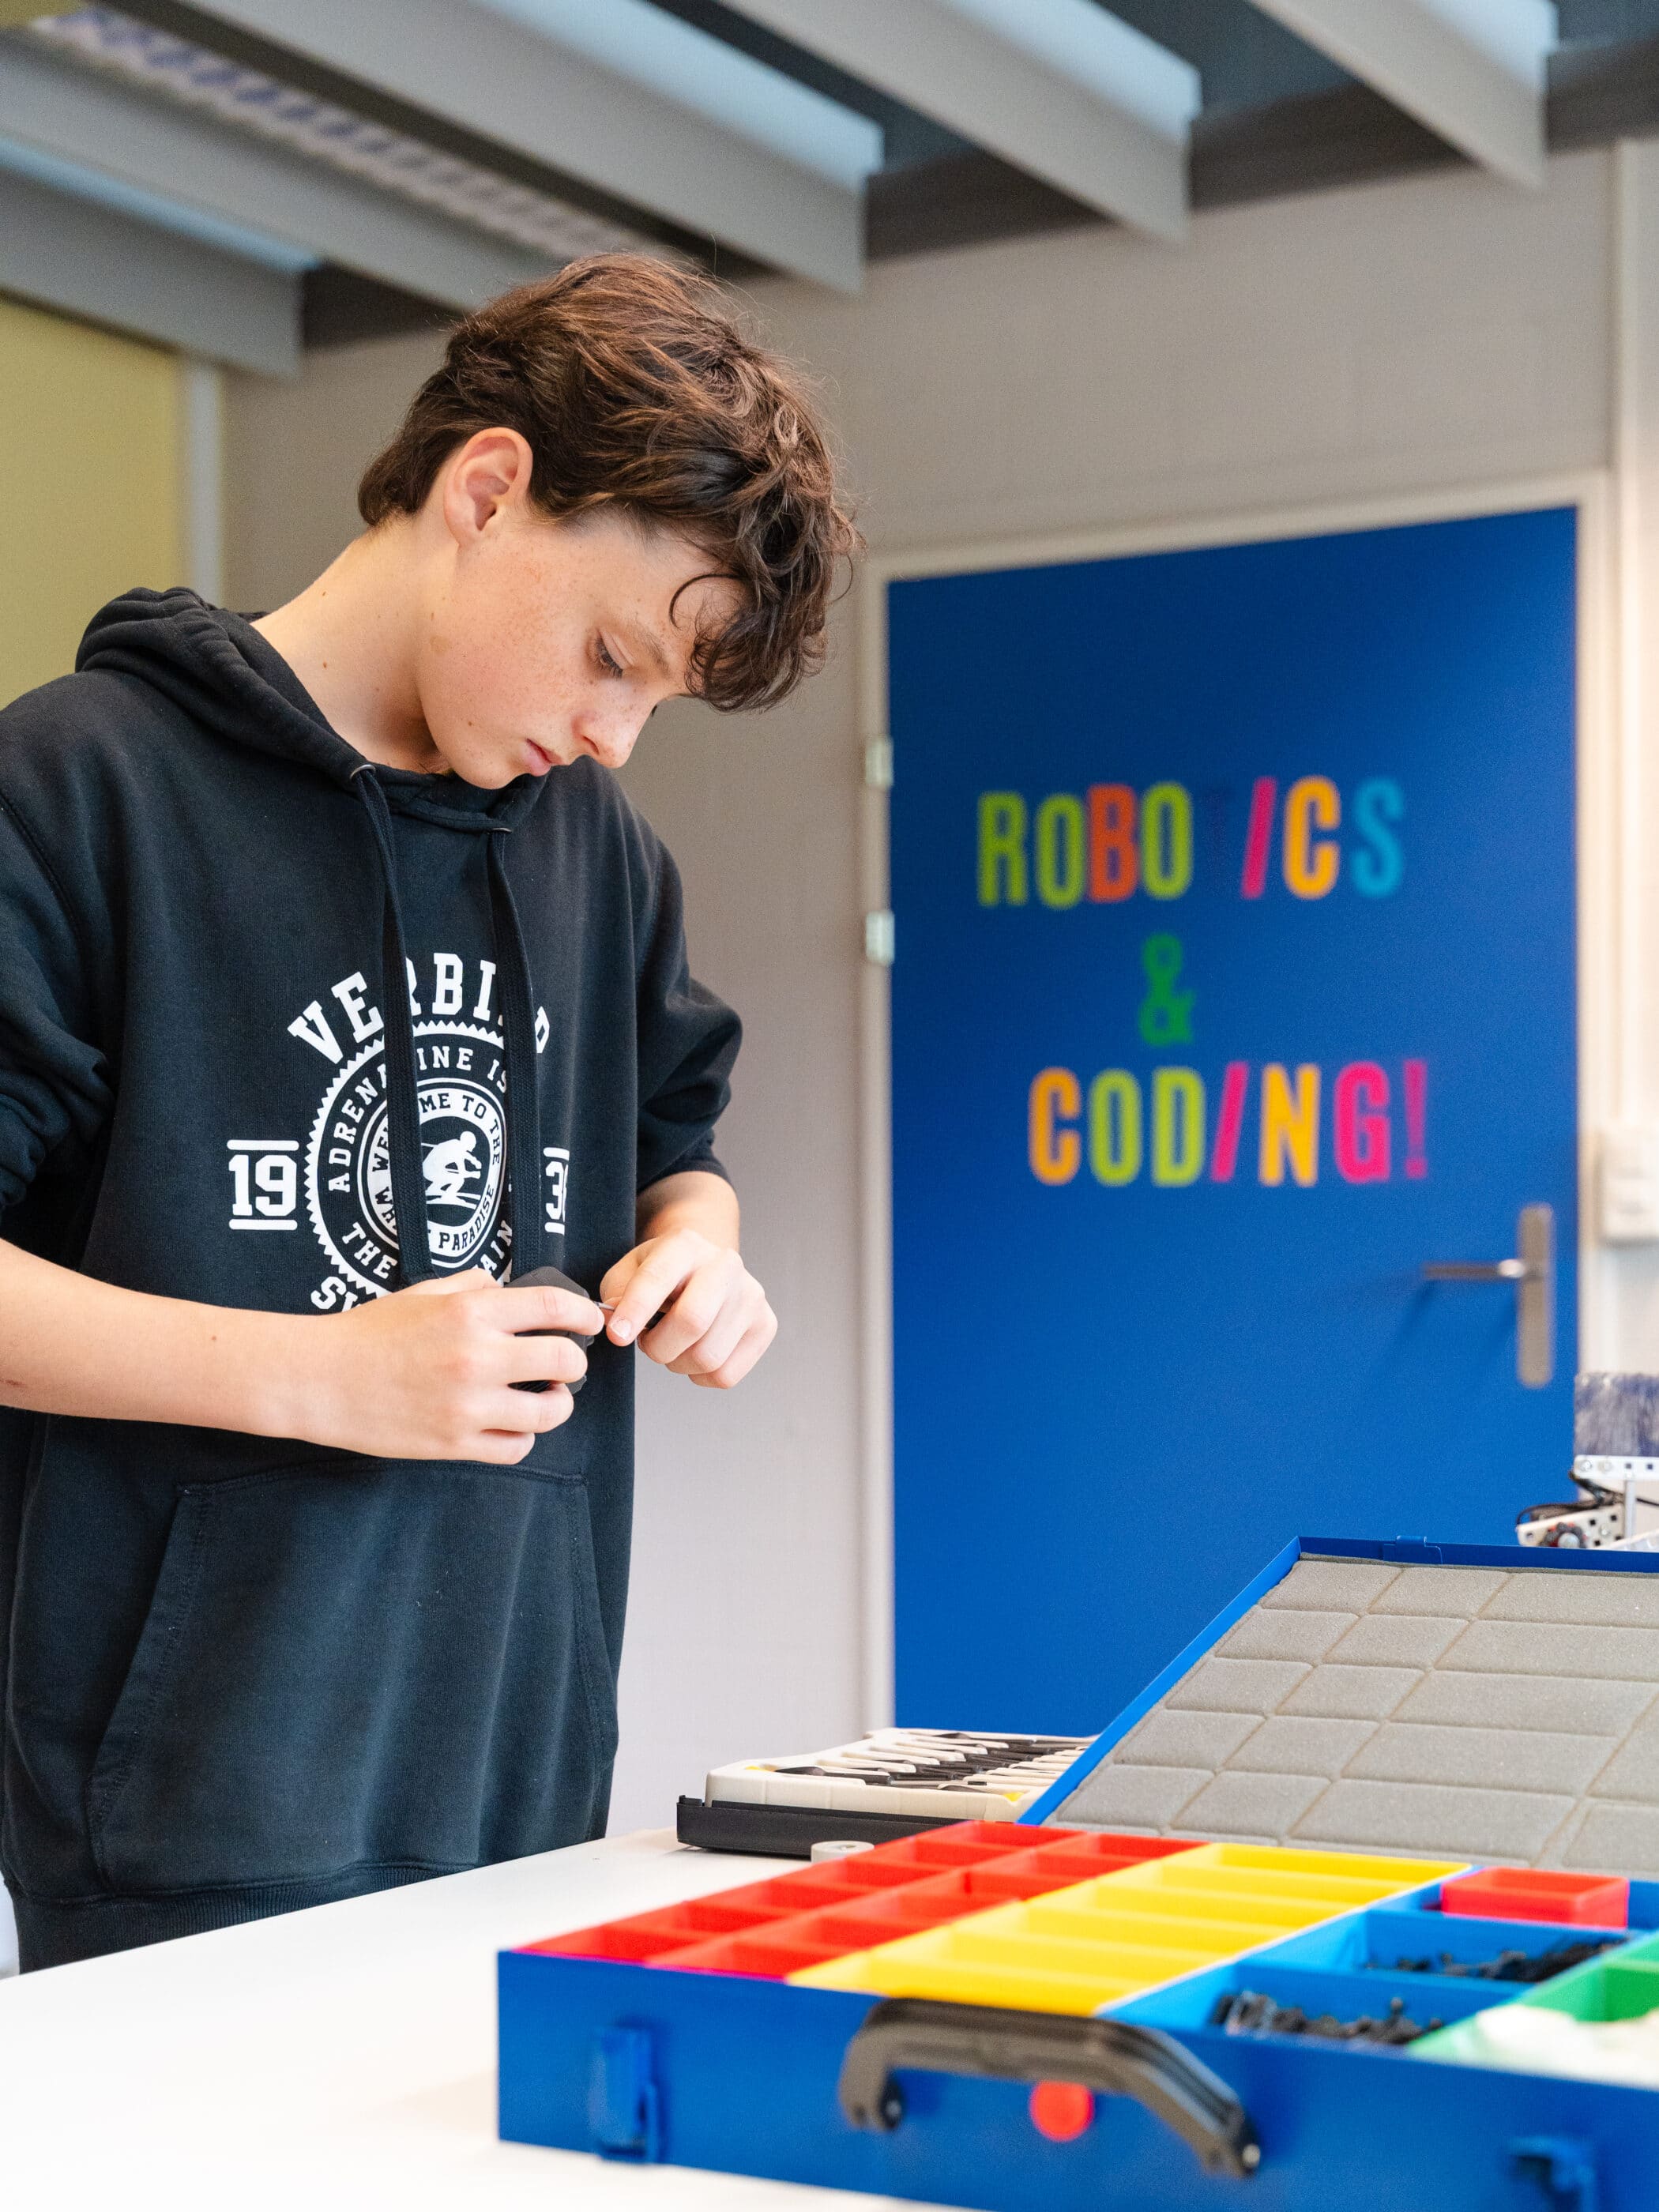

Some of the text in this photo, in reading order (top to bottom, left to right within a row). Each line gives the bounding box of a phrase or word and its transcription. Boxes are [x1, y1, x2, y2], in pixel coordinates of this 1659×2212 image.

[287, 953, 550, 1064] VEBI
[1138, 933, 1194, 1047] &
[328, 1045, 474, 1193] ADRENINE
[462, 1094, 487, 1119] TO
[228, 1154, 297, 1216] 19
[438, 1184, 494, 1251] PARADISE
[341, 1221, 398, 1272] THE
